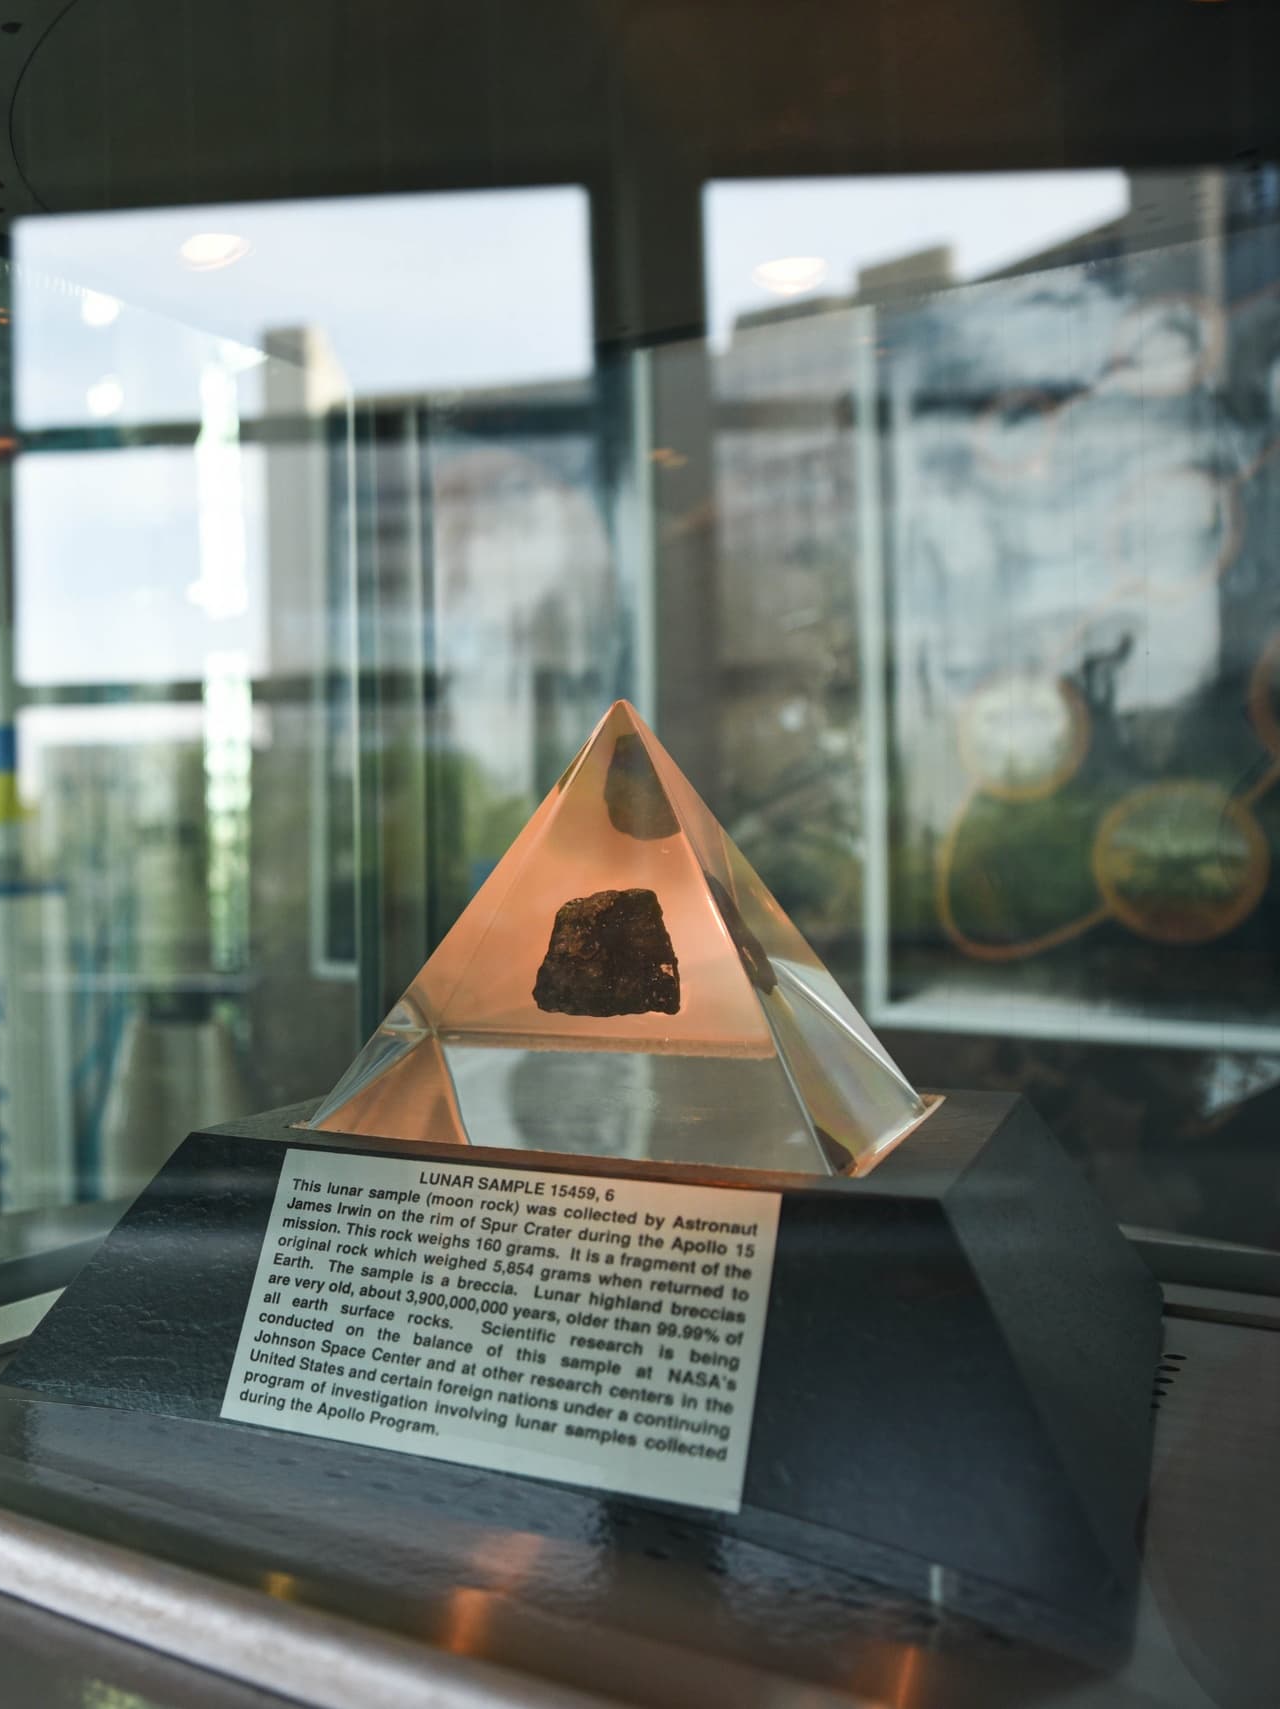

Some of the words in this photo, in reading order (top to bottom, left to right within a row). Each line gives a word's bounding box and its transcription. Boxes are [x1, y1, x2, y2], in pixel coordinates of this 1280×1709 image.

[293, 1178, 321, 1192] This
[327, 1182, 364, 1197] lunar
[368, 1189, 420, 1205] sample
[426, 1192, 473, 1208] (moon
[480, 1200, 519, 1216] rock)
[526, 1204, 557, 1216] was
[564, 1207, 637, 1224] collected
[644, 1213, 665, 1231] by
[672, 1216, 758, 1236] Astronaut
[419, 1171, 474, 1189] LUNAR
[478, 1177, 545, 1195] SAMPLE
[551, 1184, 599, 1203] 15459,
[605, 1189, 615, 1202] 6
[282, 1216, 340, 1234] mission.
[346, 1222, 376, 1238] This
[380, 1229, 413, 1242] rock
[418, 1233, 470, 1249] weighs
[476, 1237, 502, 1252] 160
[506, 1243, 559, 1259] grams.
[570, 1247, 581, 1261] It
[586, 1249, 600, 1263] is
[604, 1254, 615, 1265] a
[620, 1252, 696, 1274] fragment
[701, 1262, 720, 1276] of
[724, 1264, 752, 1280] the
[287, 1197, 332, 1213] James
[337, 1202, 372, 1218] Irwin
[377, 1209, 396, 1220] on
[402, 1209, 424, 1223] the
[430, 1213, 454, 1227] rim
[460, 1216, 476, 1229] of
[480, 1217, 518, 1235] Spur
[524, 1221, 572, 1239] Crater
[578, 1228, 631, 1248] during
[638, 1234, 664, 1249] the
[671, 1236, 728, 1256] Apollo
[736, 1244, 755, 1258] 15
[273, 1252, 313, 1269] Earth.
[329, 1259, 354, 1275] The
[360, 1266, 414, 1284] sample
[420, 1271, 434, 1285] is
[440, 1276, 450, 1287] a
[457, 1275, 517, 1296] breccia.
[534, 1285, 582, 1303] Lunar
[588, 1291, 663, 1314] highland
[670, 1301, 746, 1324] breccias
[278, 1235, 331, 1252] original
[336, 1243, 368, 1256] rock
[374, 1246, 417, 1262] which
[424, 1254, 487, 1271] weighed
[492, 1260, 534, 1277] 5,854
[540, 1268, 591, 1284] grams
[598, 1273, 642, 1290] when
[650, 1280, 725, 1299] returned
[732, 1287, 749, 1302] to
[263, 1291, 281, 1304] all
[292, 1297, 328, 1311] earth
[340, 1304, 395, 1321] surface
[407, 1314, 453, 1330] rocks.
[481, 1321, 556, 1344] Scientific
[570, 1336, 643, 1356] research
[658, 1344, 674, 1360] is
[689, 1349, 740, 1372] being
[268, 1274, 291, 1286] are
[295, 1277, 325, 1294] very
[328, 1280, 354, 1297] old,
[359, 1284, 402, 1302] about
[405, 1289, 509, 1315] 3,900,000,000
[512, 1306, 560, 1325] years,
[566, 1312, 609, 1328] older
[614, 1317, 651, 1334] than
[657, 1321, 720, 1344] 99.99%
[724, 1331, 744, 1346] of
[254, 1329, 315, 1351] Johnson
[321, 1339, 366, 1358] Space
[372, 1347, 422, 1367] Center
[426, 1358, 456, 1373] and
[461, 1363, 476, 1376] at
[482, 1366, 525, 1383] other
[530, 1374, 602, 1395] research
[609, 1385, 674, 1406] centers
[681, 1393, 698, 1410] in
[705, 1397, 734, 1415] the
[259, 1312, 334, 1333] conducted
[345, 1325, 364, 1337] on
[377, 1328, 400, 1342] the
[413, 1332, 473, 1354] balance
[486, 1344, 503, 1358] of
[516, 1348, 546, 1364] this
[560, 1356, 622, 1376] sample
[635, 1366, 653, 1380] at
[668, 1368, 737, 1392] NASA's
[240, 1388, 286, 1411] during
[290, 1397, 313, 1413] the
[316, 1402, 365, 1422] Apollo
[369, 1410, 439, 1436] Program.
[243, 1371, 304, 1391] program
[311, 1381, 327, 1394] of
[331, 1382, 428, 1411] investigation
[435, 1400, 508, 1428] involving
[515, 1413, 558, 1433] lunar
[564, 1424, 637, 1447] samples
[644, 1437, 728, 1461] collected
[250, 1348, 296, 1368] United
[299, 1357, 344, 1376] States
[348, 1368, 377, 1381] and
[380, 1373, 432, 1390] certain
[437, 1379, 493, 1402] foreign
[498, 1392, 558, 1411] nations
[563, 1402, 613, 1419] under
[618, 1410, 628, 1422] a
[633, 1412, 730, 1441] continuing
